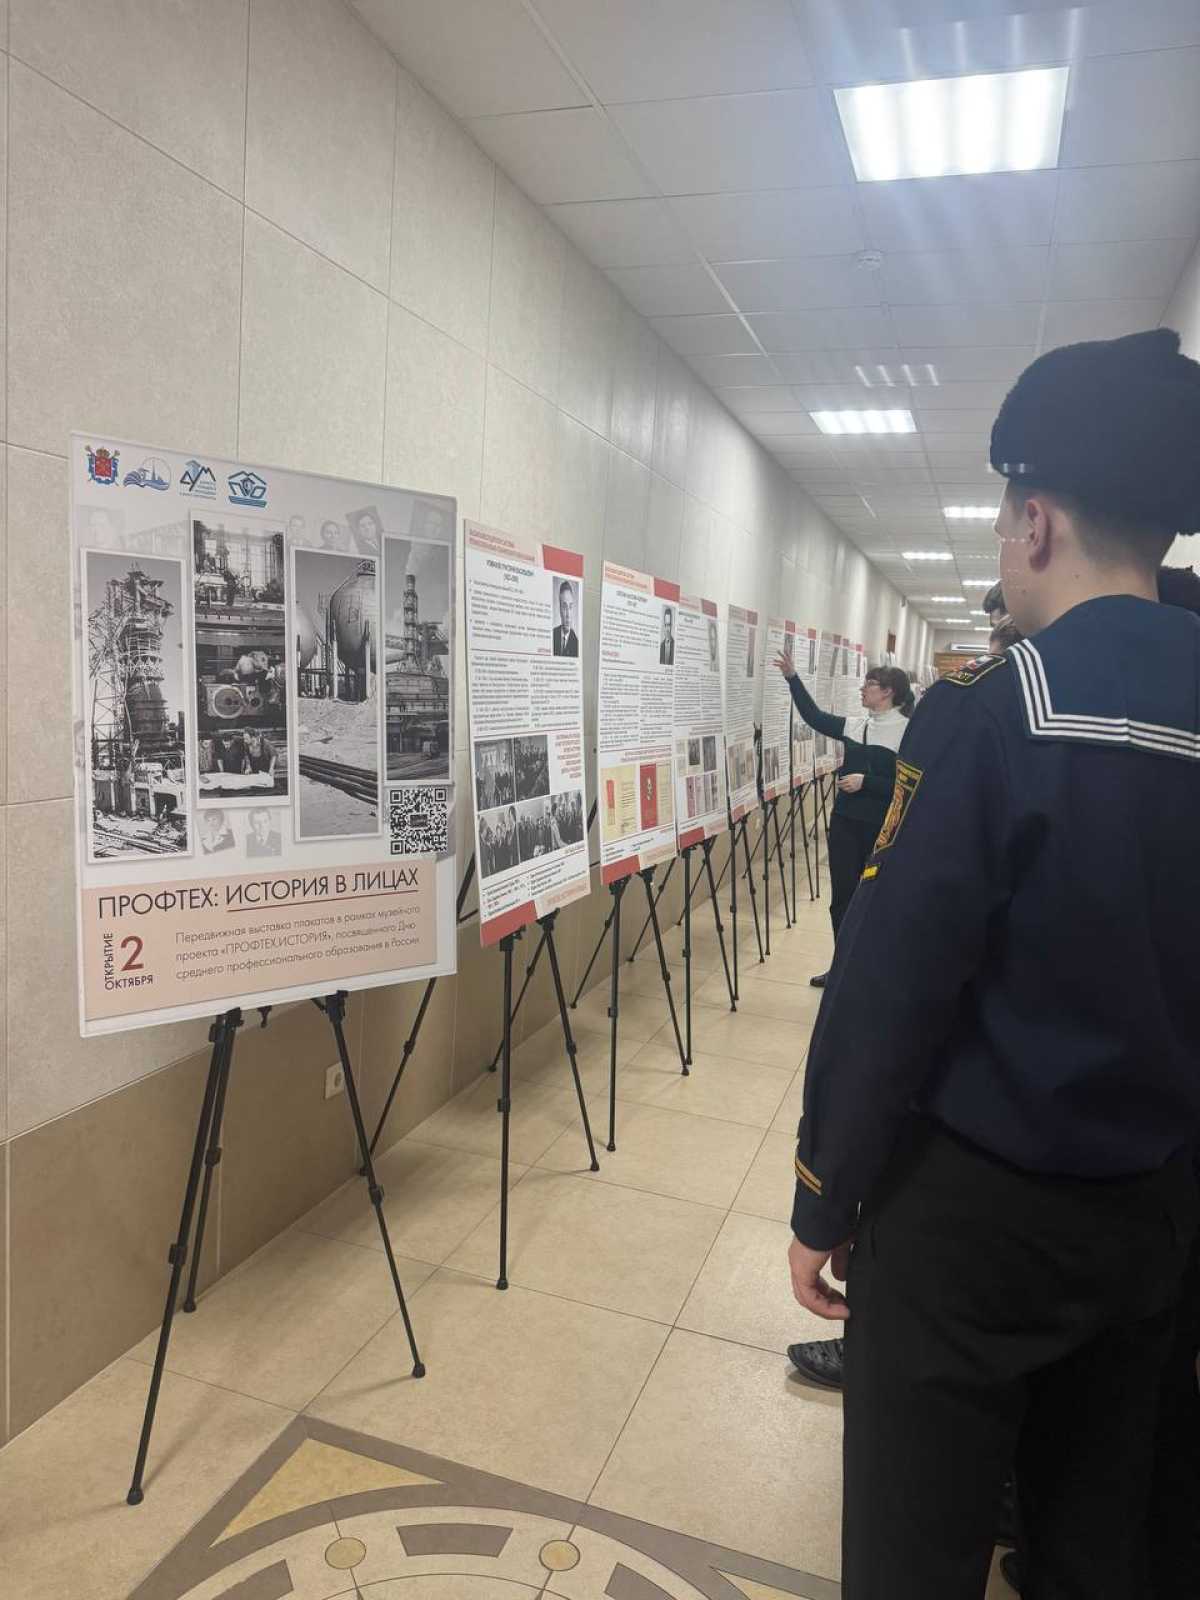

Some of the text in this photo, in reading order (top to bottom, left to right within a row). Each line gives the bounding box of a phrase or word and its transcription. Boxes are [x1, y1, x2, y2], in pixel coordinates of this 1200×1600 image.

[99, 867, 418, 918] ПРОФТЕХ: ИСТОРИЯ В ЛИЦАХ
[175, 928, 247, 945] Передвижная
[249, 922, 291, 934] выставка
[294, 917, 335, 927] плакатов
[344, 912, 376, 924] рамках
[103, 933, 119, 990] ОТКРЫТИЕ
[120, 936, 144, 971] 2
[175, 965, 225, 981] среднего
[226, 950, 324, 972] профессионального
[325, 942, 383, 957] образования
[176, 948, 219, 964] проекта
[105, 975, 153, 990] ОКТЯБРЯ
